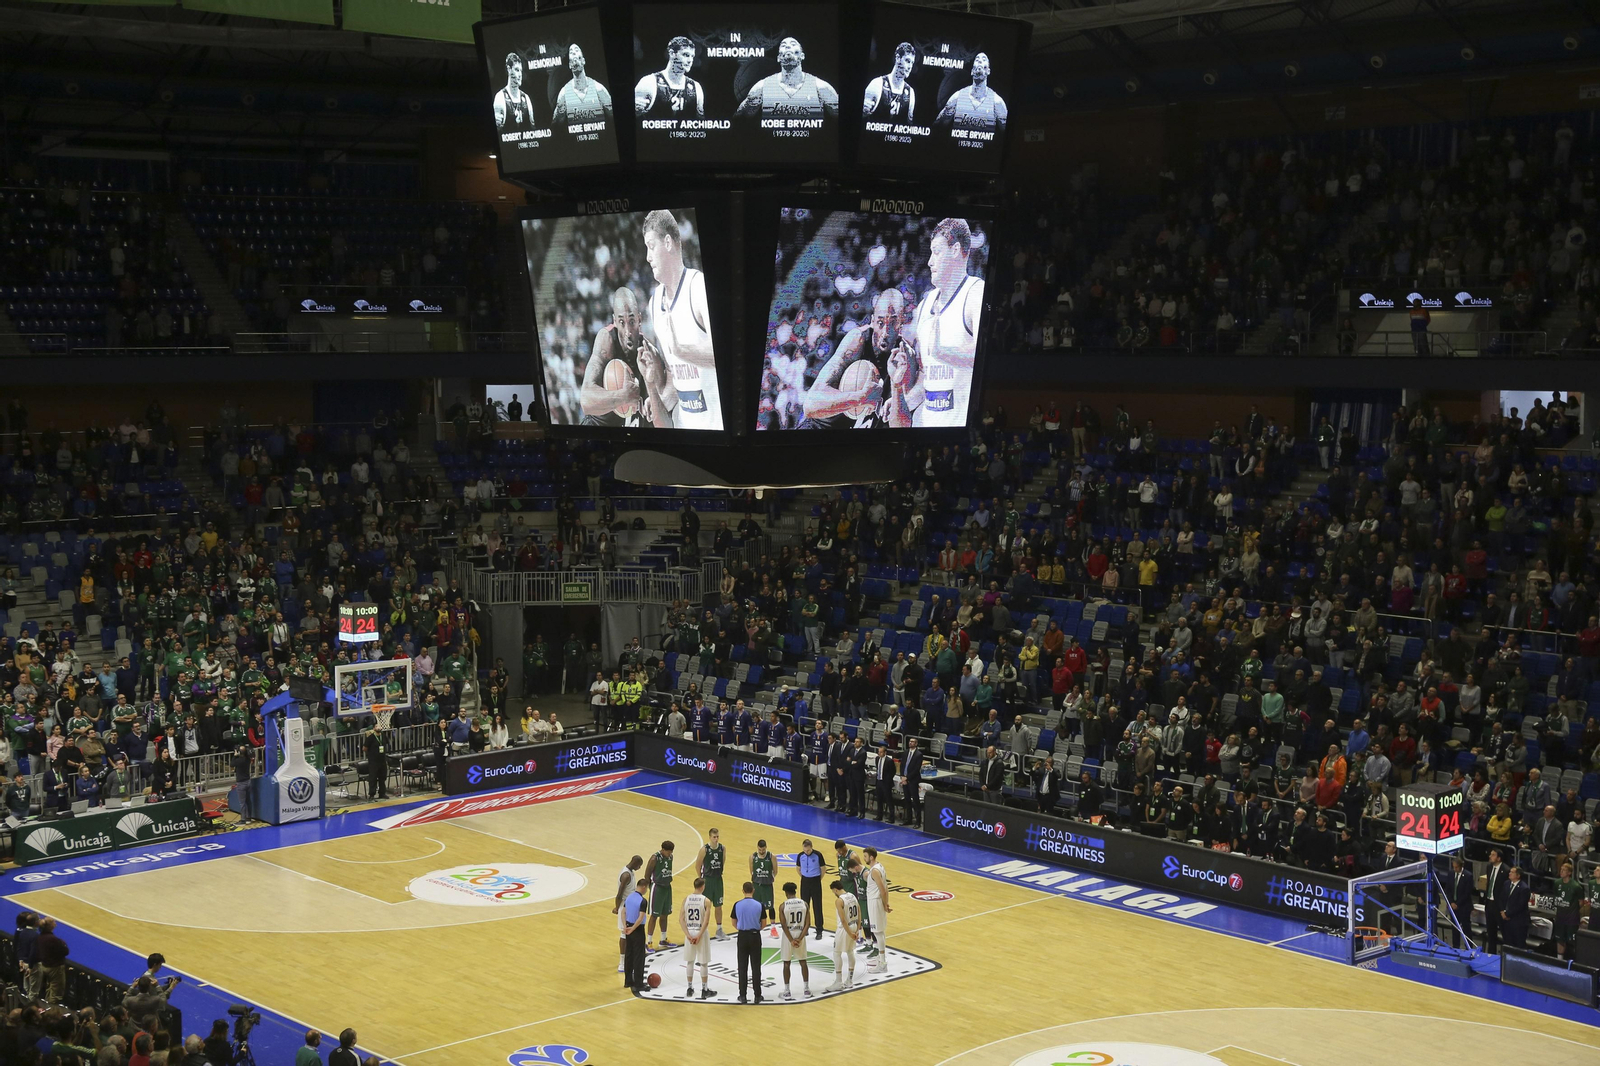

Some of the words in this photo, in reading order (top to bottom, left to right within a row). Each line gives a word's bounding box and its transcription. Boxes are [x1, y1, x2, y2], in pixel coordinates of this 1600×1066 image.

[730, 33, 741, 43] IN
[538, 44, 546, 54] IN
[707, 47, 765, 58] MEMORIAM
[941, 43, 950, 53] IN
[528, 56, 562, 70] MEMORIAM
[922, 56, 964, 70] MEMORIAM
[568, 124, 583, 133] KOBE
[583, 121, 606, 132] BRYANT
[642, 120, 678, 129] ROBERT
[680, 120, 731, 129] ARCHIBALD
[761, 119, 785, 128] KOBE
[787, 119, 823, 128] BRYANT
[865, 122, 893, 132] ROBERT
[893, 124, 931, 136] ARCHIBALD
[501, 132, 522, 142] ROBERT
[522, 128, 551, 140] ARCHIBALD
[951, 129, 969, 139] KOBE
[969, 131, 995, 140] BRYANT
[587, 199, 629, 214] MONDO
[872, 198, 924, 215] MONDO
[355, 606, 378, 616] 10:00
[340, 617, 352, 633] 24
[356, 617, 376, 633] 24
[569, 751, 627, 769] GREATNESS
[677, 754, 706, 770] EuroCup
[484, 764, 524, 777] EuroCup
[741, 772, 792, 793] GREATNESS
[1400, 793, 1435, 810] 10:00
[1439, 792, 1463, 809] 10:00
[152, 816, 196, 835] Unicaja
[955, 815, 994, 834] EuroCup
[1400, 811, 1431, 839] 24
[1439, 810, 1460, 839] 24
[63, 831, 111, 851] Unicaja
[1039, 839, 1105, 864] GREATNESS
[12, 842, 226, 883] @unicajaCB
[1182, 864, 1228, 887] EuroCup
[977, 859, 1218, 919] MALAGA
[687, 908, 700, 921] 23
[789, 911, 803, 924] 10
[848, 905, 858, 919] 30
[1418, 961, 1437, 969] MONDO
